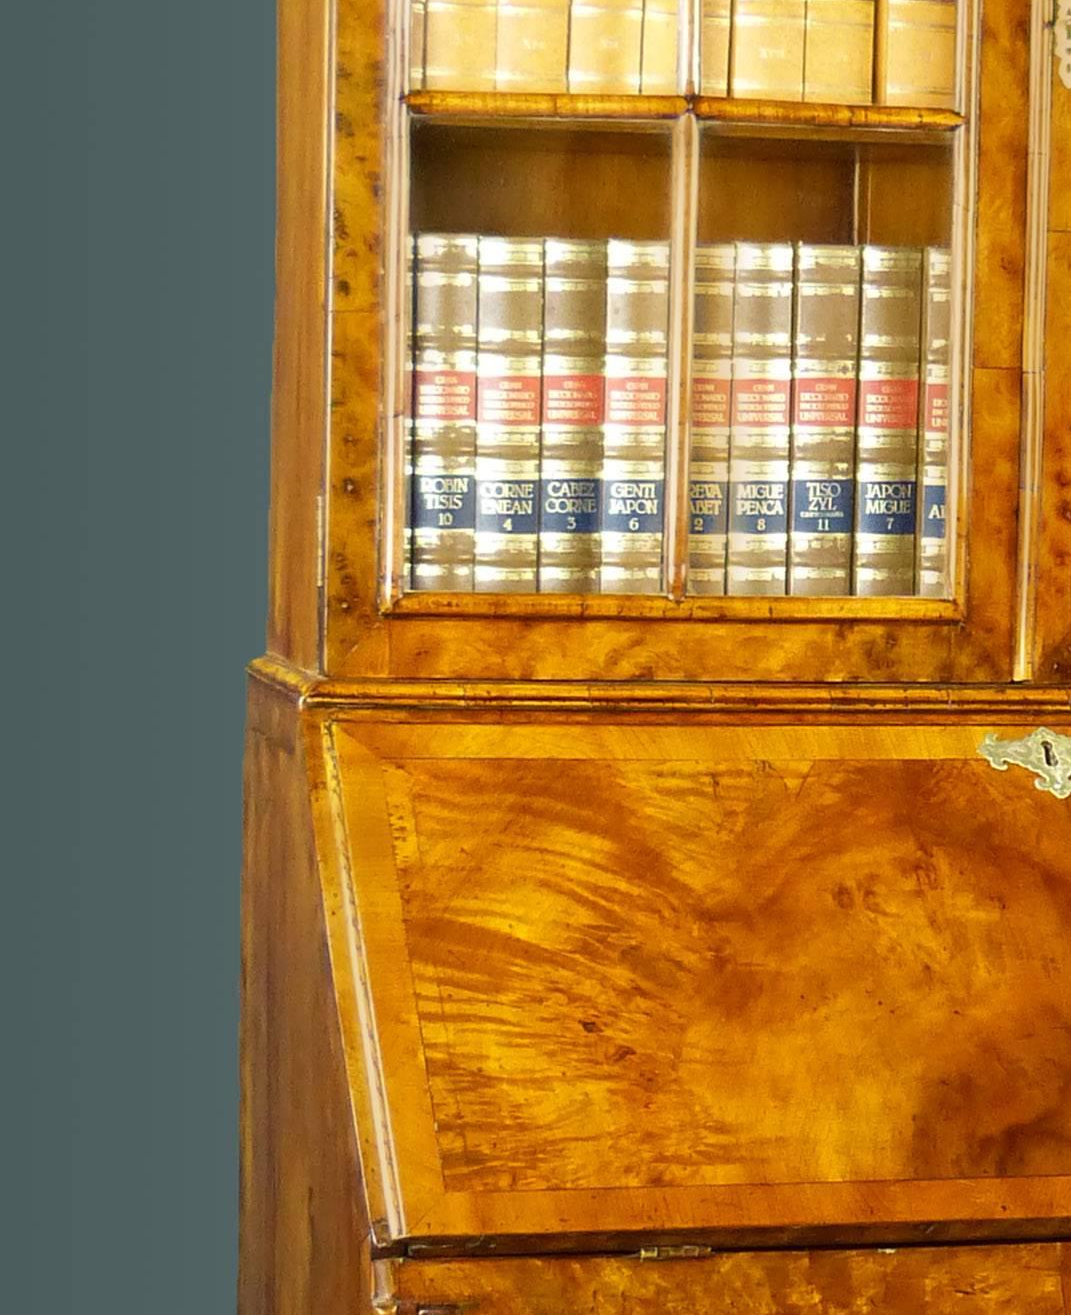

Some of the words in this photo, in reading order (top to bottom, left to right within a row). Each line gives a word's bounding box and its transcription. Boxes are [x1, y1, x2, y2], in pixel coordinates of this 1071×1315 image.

[420, 477, 468, 494] ROBIN
[480, 482, 534, 499] CORNE
[547, 481, 596, 498] CABEZ
[610, 484, 656, 499] GENTI
[736, 484, 784, 499] MIGUE
[806, 483, 841, 499] TISO
[865, 484, 911, 500] JAPON
[425, 494, 462, 510] TISIS
[480, 499, 532, 515] ENEAN
[545, 498, 597, 515] CORNE
[608, 499, 658, 515] JAPON
[736, 500, 784, 516] PENCA
[808, 497, 837, 511] ZYL
[865, 500, 911, 515] MIGUE
[438, 514, 453, 528] 10
[503, 519, 513, 532] 4
[566, 518, 577, 531] 3
[629, 518, 640, 531] 6
[693, 518, 704, 531] 2
[756, 518, 766, 531] 8
[817, 519, 830, 531] 11
[886, 518, 894, 530] 7
